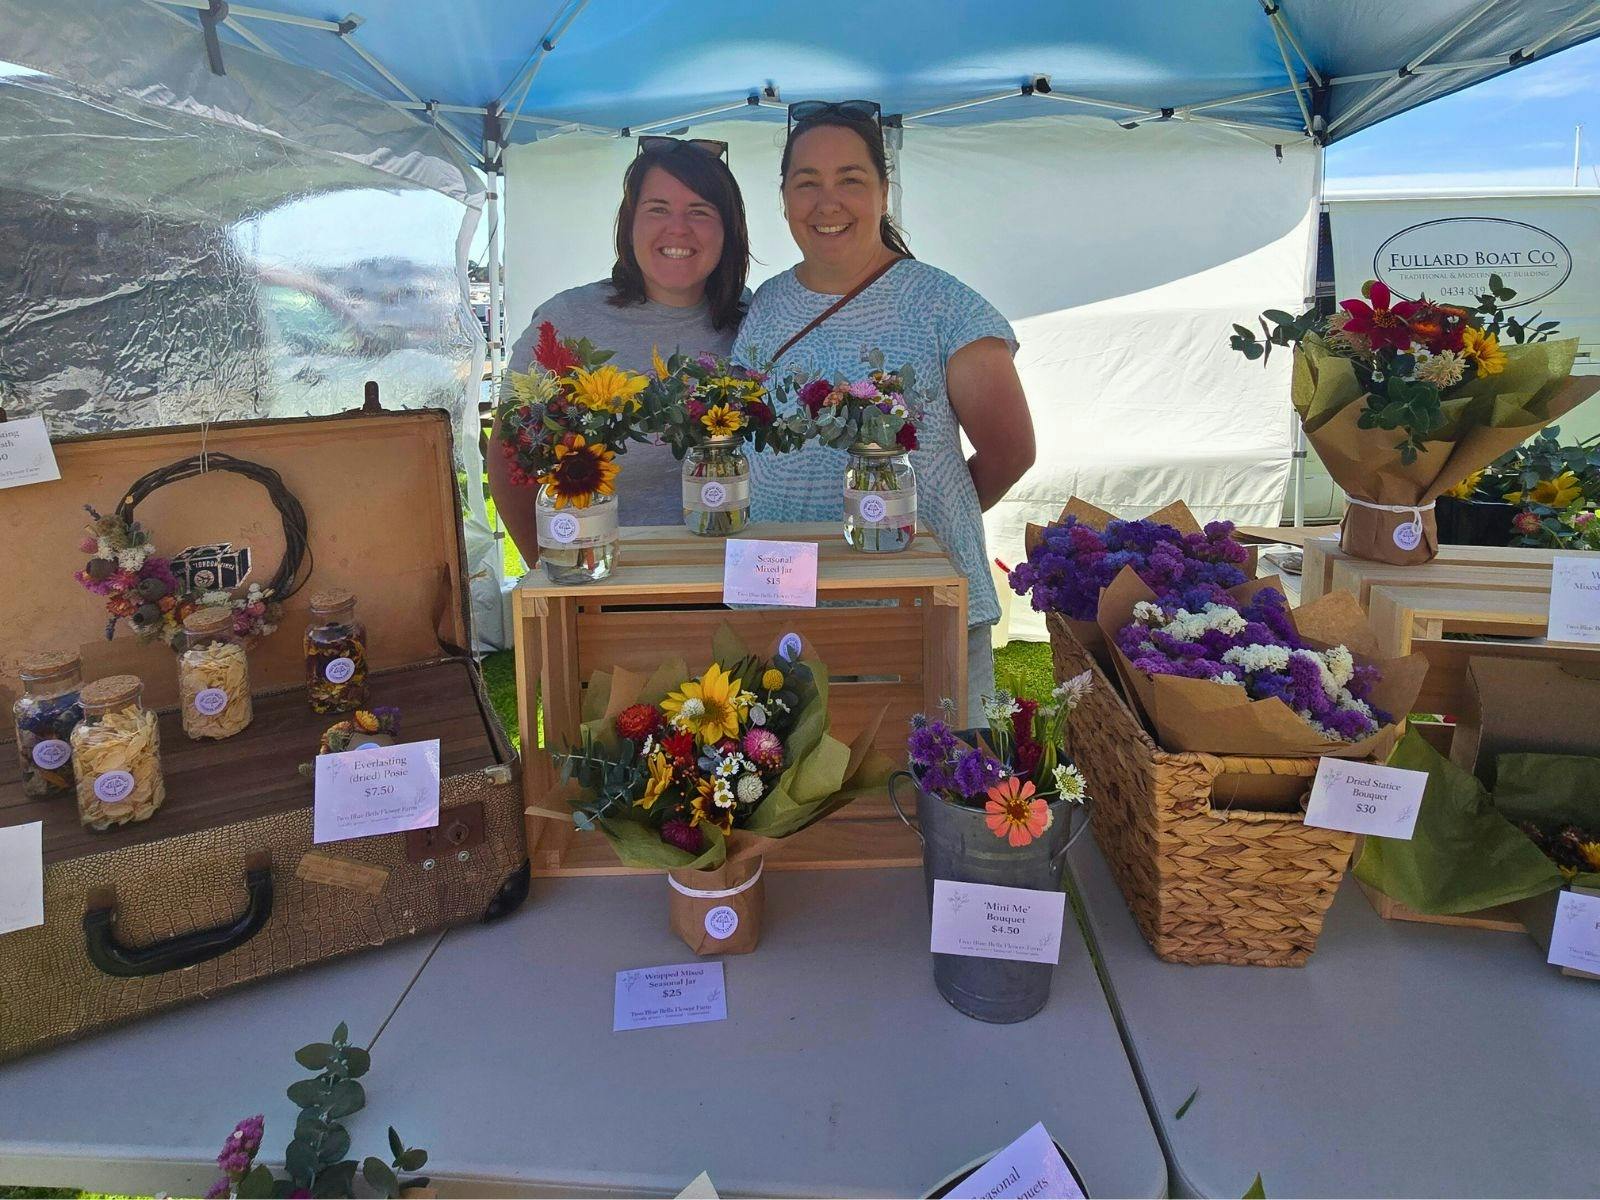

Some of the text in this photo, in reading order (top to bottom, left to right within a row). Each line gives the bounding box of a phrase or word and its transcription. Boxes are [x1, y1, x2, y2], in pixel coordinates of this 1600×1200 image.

[1390, 252, 1468, 267] FULLARD
[1475, 251, 1522, 265] BOAT
[1440, 286, 1465, 296] 0434
[757, 554, 792, 564] Seasonal
[756, 564, 793, 575] Mixed Jar
[766, 576, 781, 585] $15
[354, 756, 408, 770] Everlasting
[349, 769, 409, 784] (dried) Posie
[1346, 775, 1402, 791] Dried Statice
[364, 785, 395, 798] $7.50
[1353, 788, 1388, 801] Bouquet
[1356, 803, 1377, 814] $30
[986, 913, 1026, 924] Bouquet
[991, 925, 1020, 935] $4.50
[644, 969, 704, 981] Wrapped Mixed
[648, 978, 696, 989] Seasonal Jar
[662, 988, 682, 999] $25
